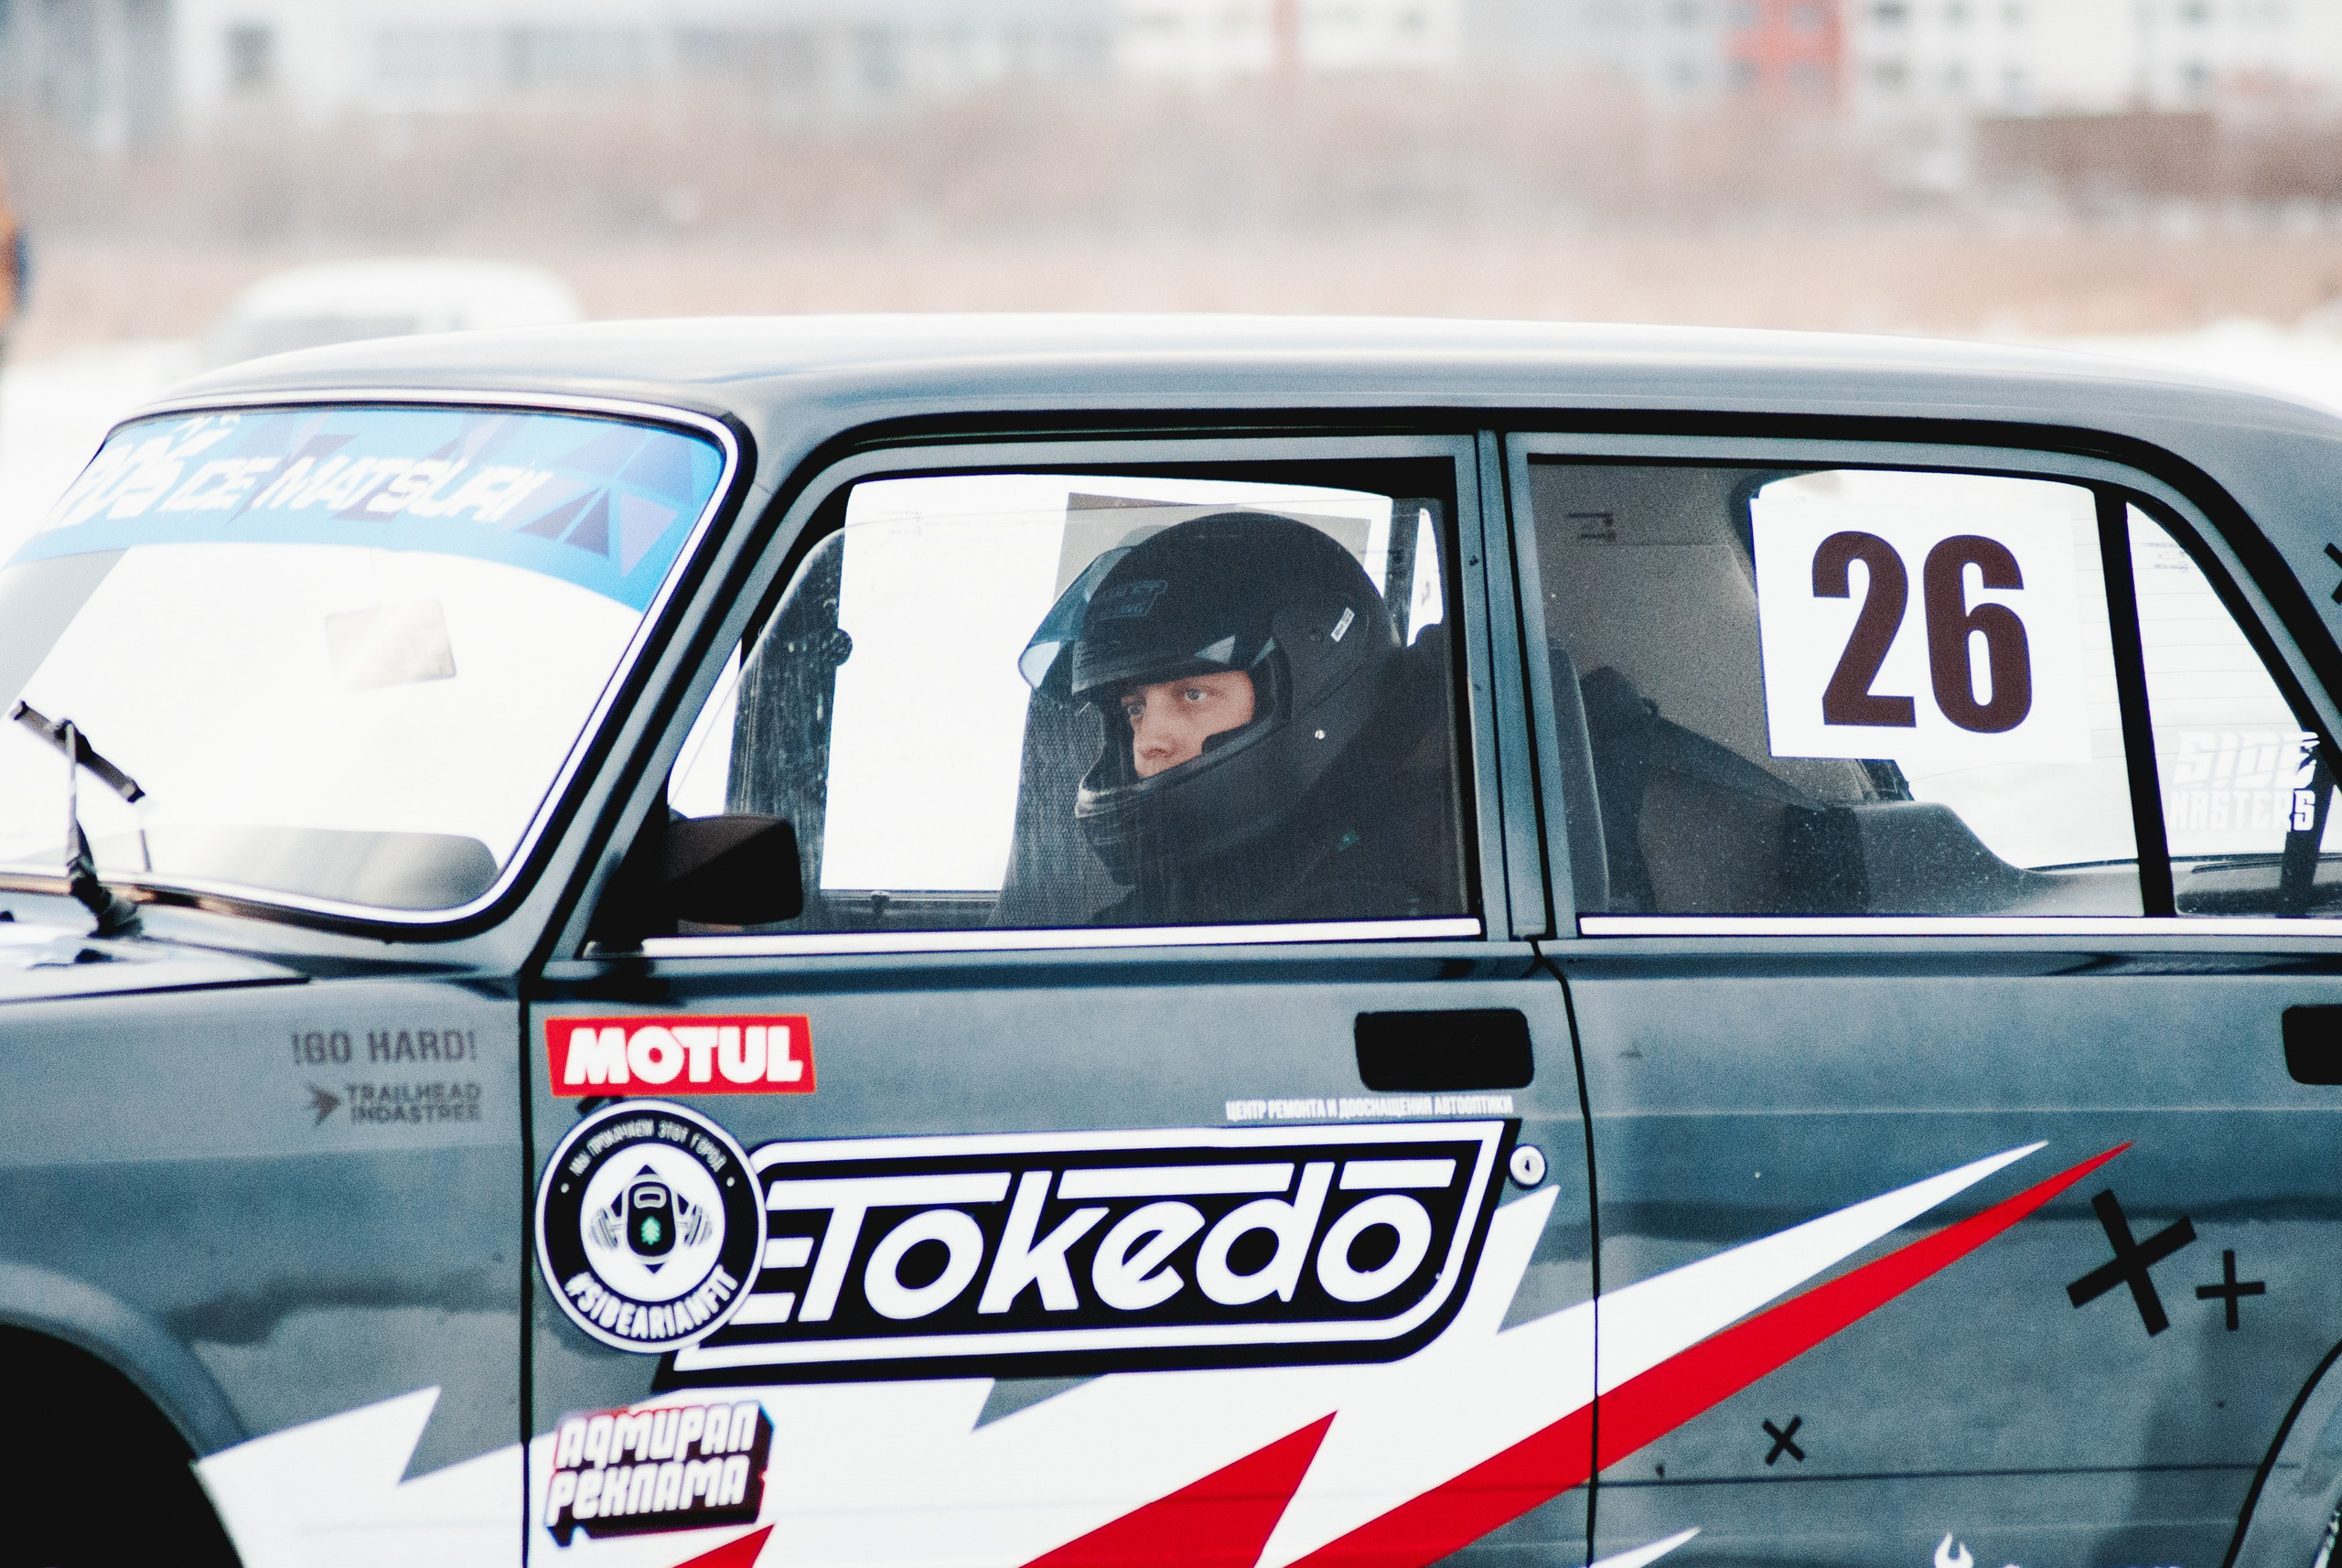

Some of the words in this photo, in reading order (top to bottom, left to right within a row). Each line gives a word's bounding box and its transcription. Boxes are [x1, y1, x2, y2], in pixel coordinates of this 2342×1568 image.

[1811, 530, 2032, 734] 26
[2172, 731, 2320, 789] SIDE
[368, 1028, 478, 1063] HARD!
[564, 1026, 803, 1084] MOTUL
[1225, 1100, 1267, 1122] ЦЕНТР
[1267, 1099, 1327, 1120] РЕМОНТА
[1327, 1098, 1338, 1118] И
[1434, 1095, 1514, 1115] АВТООПТИКИ
[658, 1121, 689, 1144] ЭТОТ
[690, 1133, 728, 1173] ГОРОД
